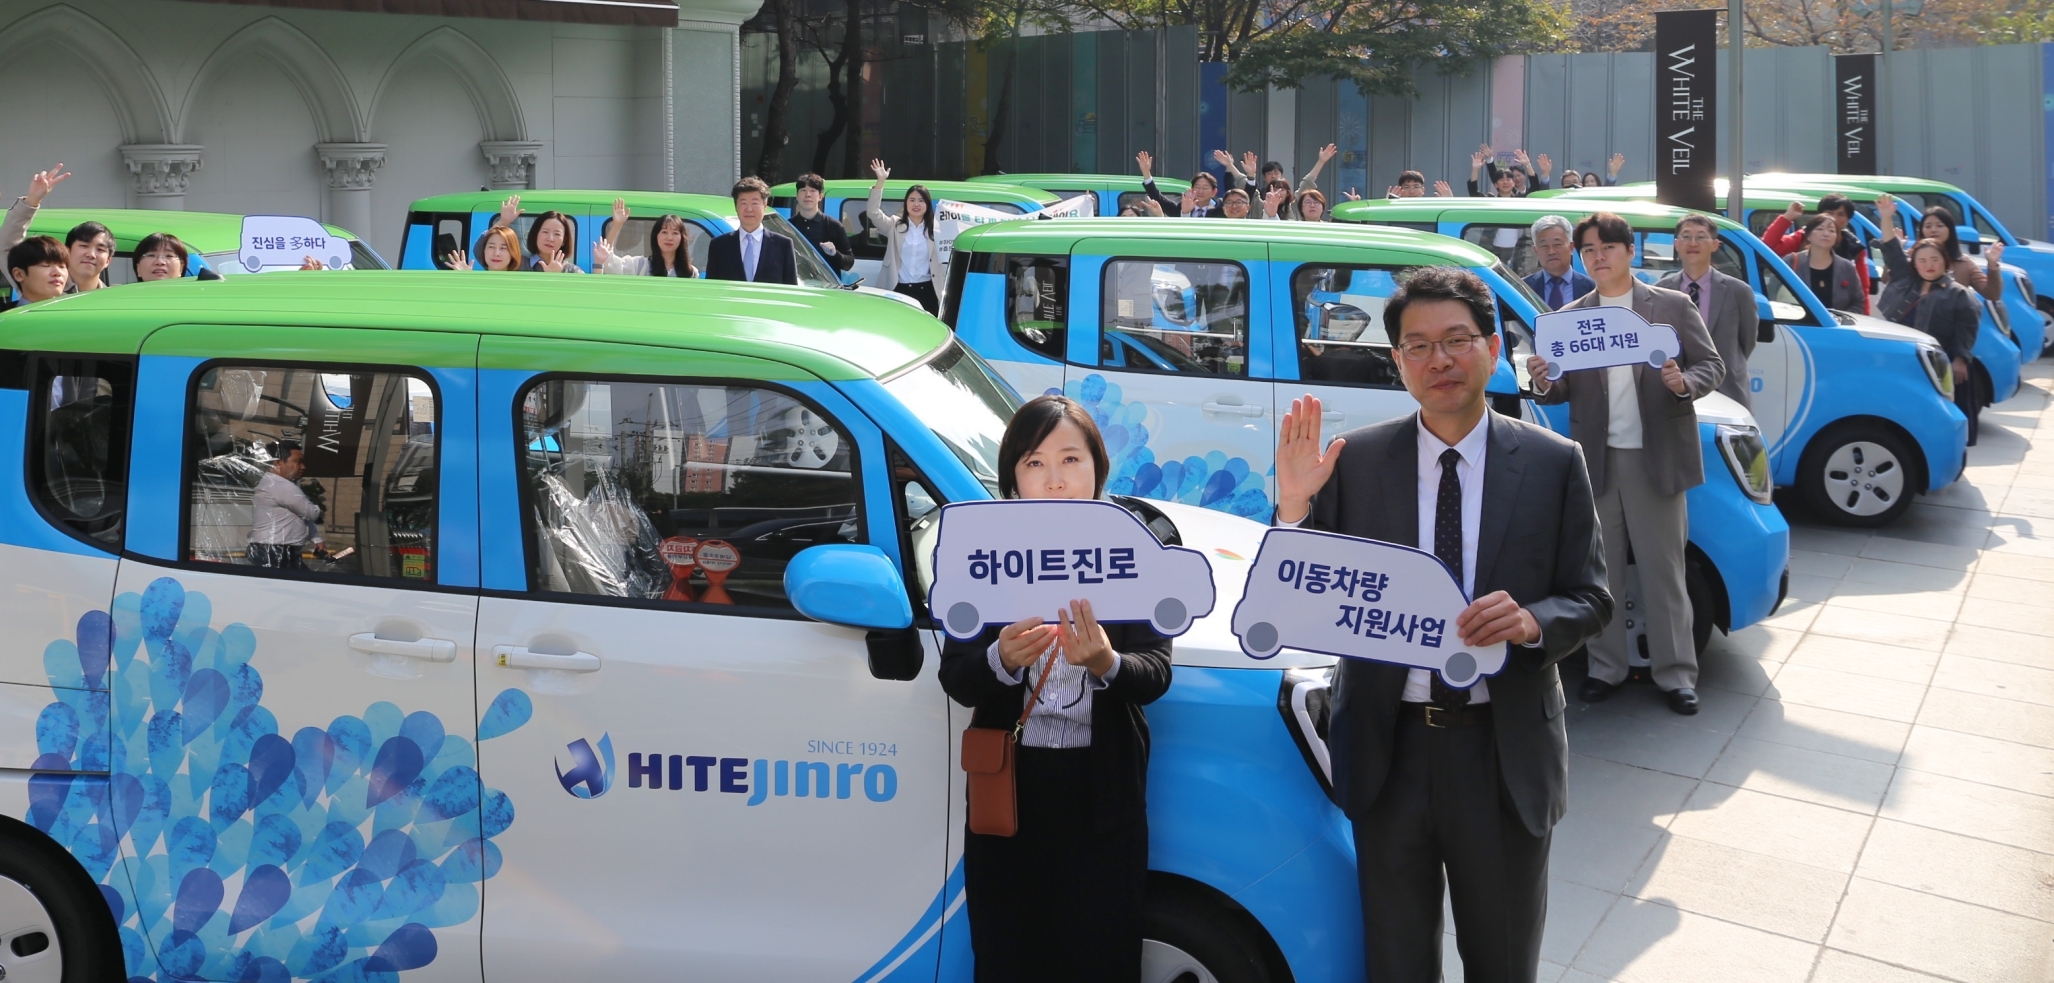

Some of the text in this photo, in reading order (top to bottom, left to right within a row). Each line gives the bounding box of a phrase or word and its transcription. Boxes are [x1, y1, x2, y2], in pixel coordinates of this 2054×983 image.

[1668, 43, 1695, 175] WHITE VEIL
[1692, 97, 1704, 121] THE
[1843, 75, 1863, 158] WHITE VEIL
[1860, 108, 1868, 123] THE
[251, 236, 326, 251] 진심을 多하다
[1577, 318, 1606, 336] 전국
[1551, 332, 1640, 358] 총 66대 지원
[967, 547, 1139, 585] 하이트진로
[1278, 559, 1390, 603] 이동차량
[1335, 604, 1446, 648] 지원사업
[808, 739, 898, 757] SINCE 1924
